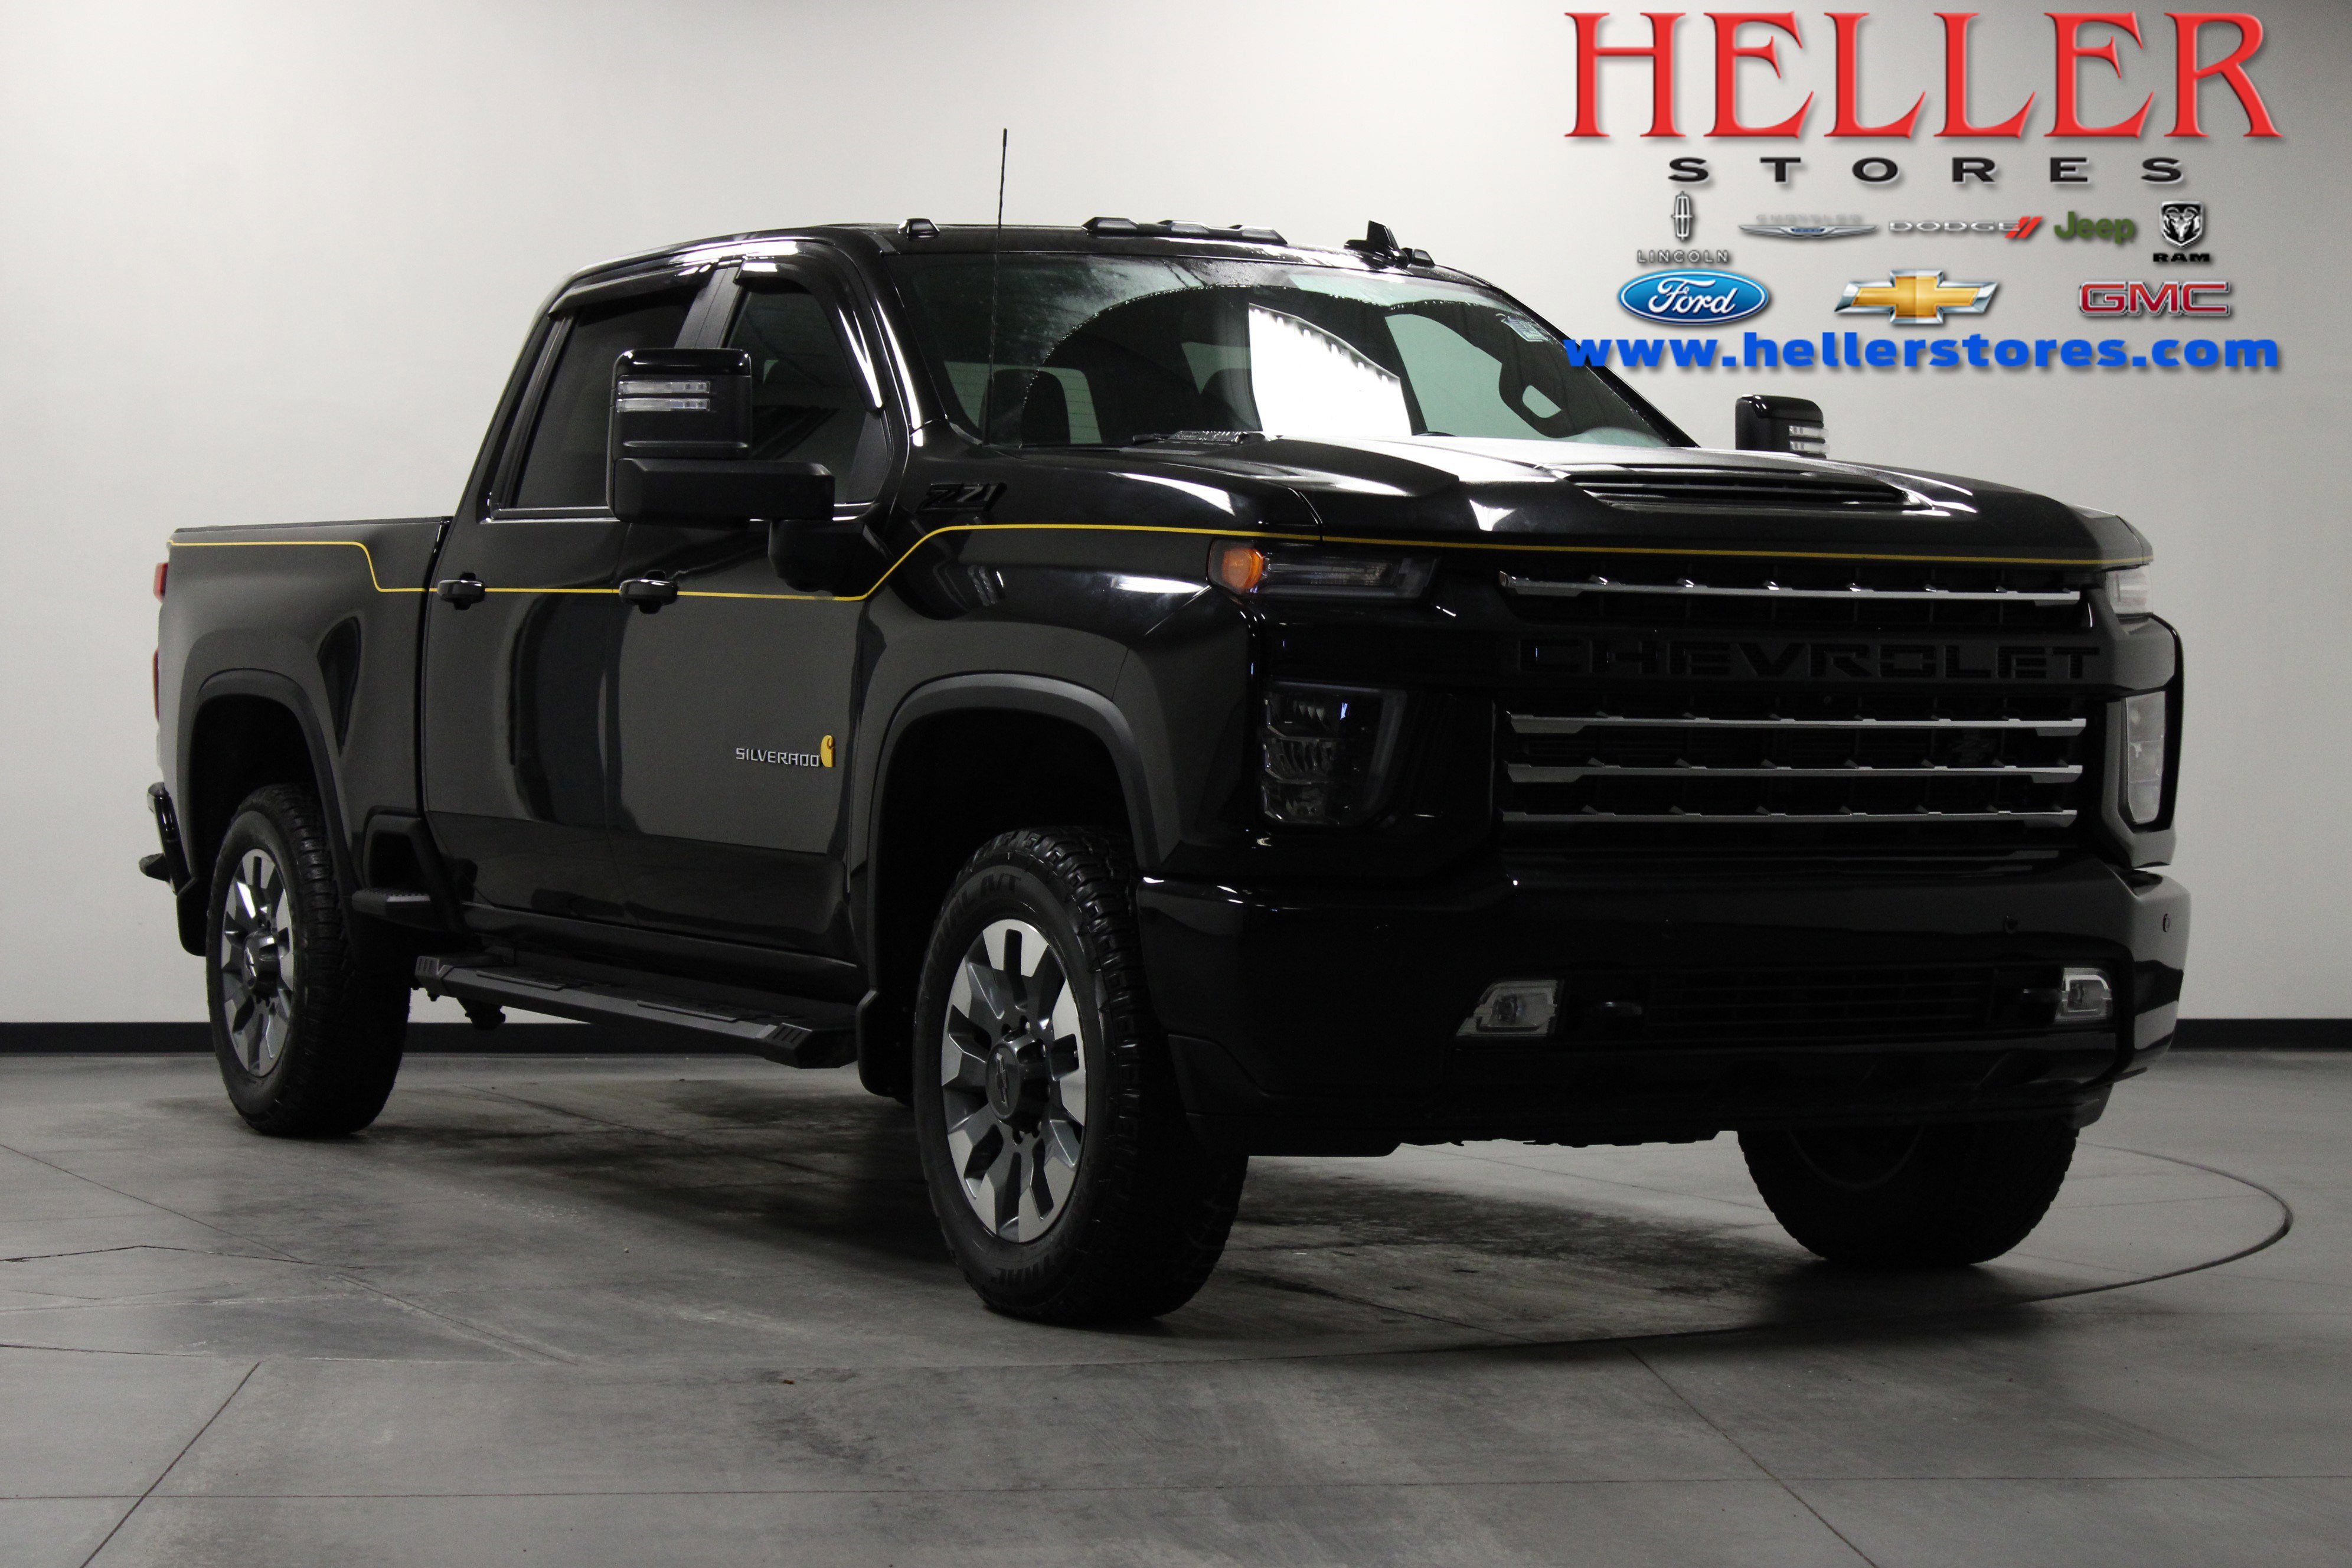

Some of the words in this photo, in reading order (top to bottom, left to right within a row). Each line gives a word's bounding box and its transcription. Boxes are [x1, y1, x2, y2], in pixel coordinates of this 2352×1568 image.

[916, 482, 1008, 513] Z71
[1517, 639, 2099, 680] CHEVROLET
[736, 747, 820, 767] SILVERADO
